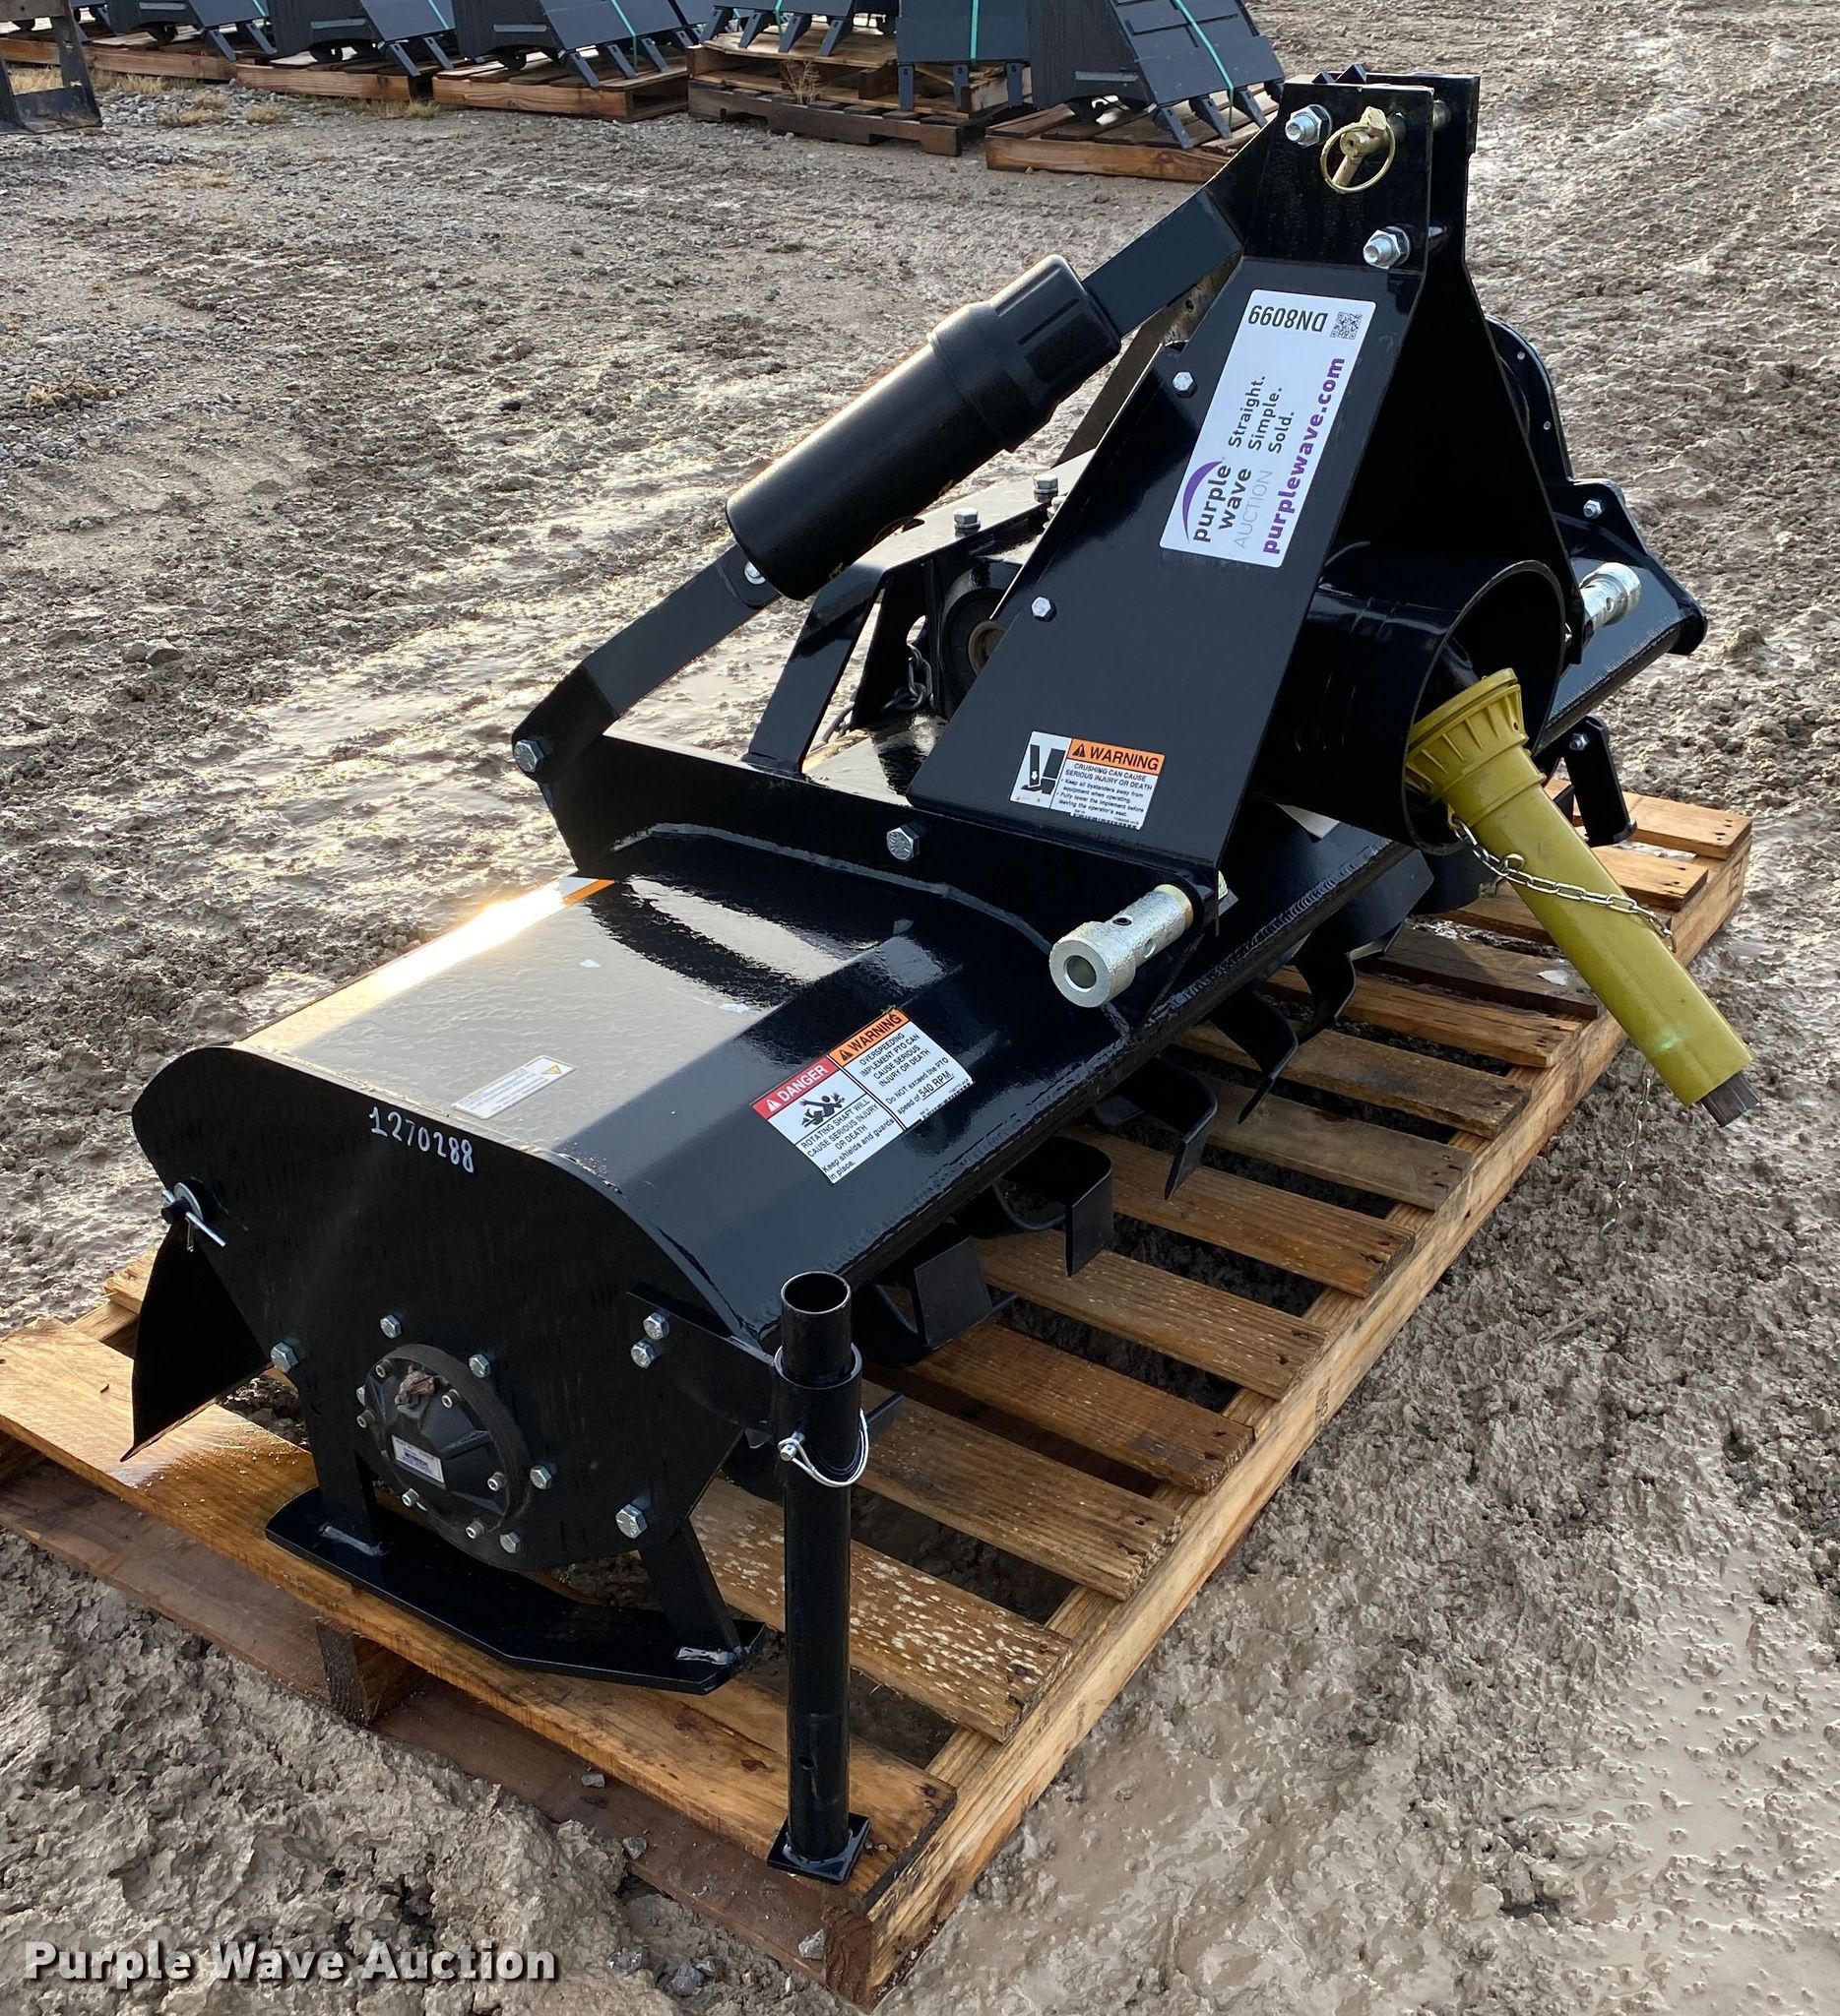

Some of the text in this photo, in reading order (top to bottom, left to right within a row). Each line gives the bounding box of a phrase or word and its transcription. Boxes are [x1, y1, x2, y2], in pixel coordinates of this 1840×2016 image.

[1247, 305, 1329, 333] DN8099
[1228, 375, 1266, 448] Straight.
[1248, 388, 1283, 451] Simple.
[1268, 411, 1295, 454] Sold.
[1262, 357, 1345, 554] purplewave.com
[1193, 465, 1232, 542] purple
[1219, 468, 1251, 531] wave
[1233, 470, 1273, 549] AUCTION
[1074, 763, 1147, 783] CRUSHING CAN CAUSE
[1090, 746, 1159, 771] WARNING
[1064, 779, 1078, 788] Keep
[1086, 783, 1114, 792] bystanders
[1065, 769, 1153, 790] SERIOUS INJURY OR DEATH
[1099, 800, 1126, 810] implement
[848, 1014, 903, 1052] WARNING
[858, 1032, 905, 1066] OVERSPEEDING
[859, 1034, 920, 1077] IMPLEMENT PTO CAN
[873, 1044, 920, 1080] CAUSE SERIOUS
[878, 1048, 931, 1088] INJURY OR DEATH
[776, 1064, 829, 1102] DANGER
[894, 1086, 910, 1099] NOT
[908, 1072, 927, 1090] exceed
[926, 1066, 937, 1076] the
[934, 1056, 949, 1069] PTO
[897, 1100, 916, 1115] speed
[918, 1084, 934, 1098] 540
[368, 1105, 475, 1173] 1270288
[800, 1098, 871, 1150] ROTATING SHAFT WILL
[806, 1102, 879, 1158] CAUSE SERIOUS INJURY
[835, 1123, 868, 1151] OR DEATH
[822, 1117, 895, 1173] Keep shields and guards
[836, 1161, 856, 1177] place.
